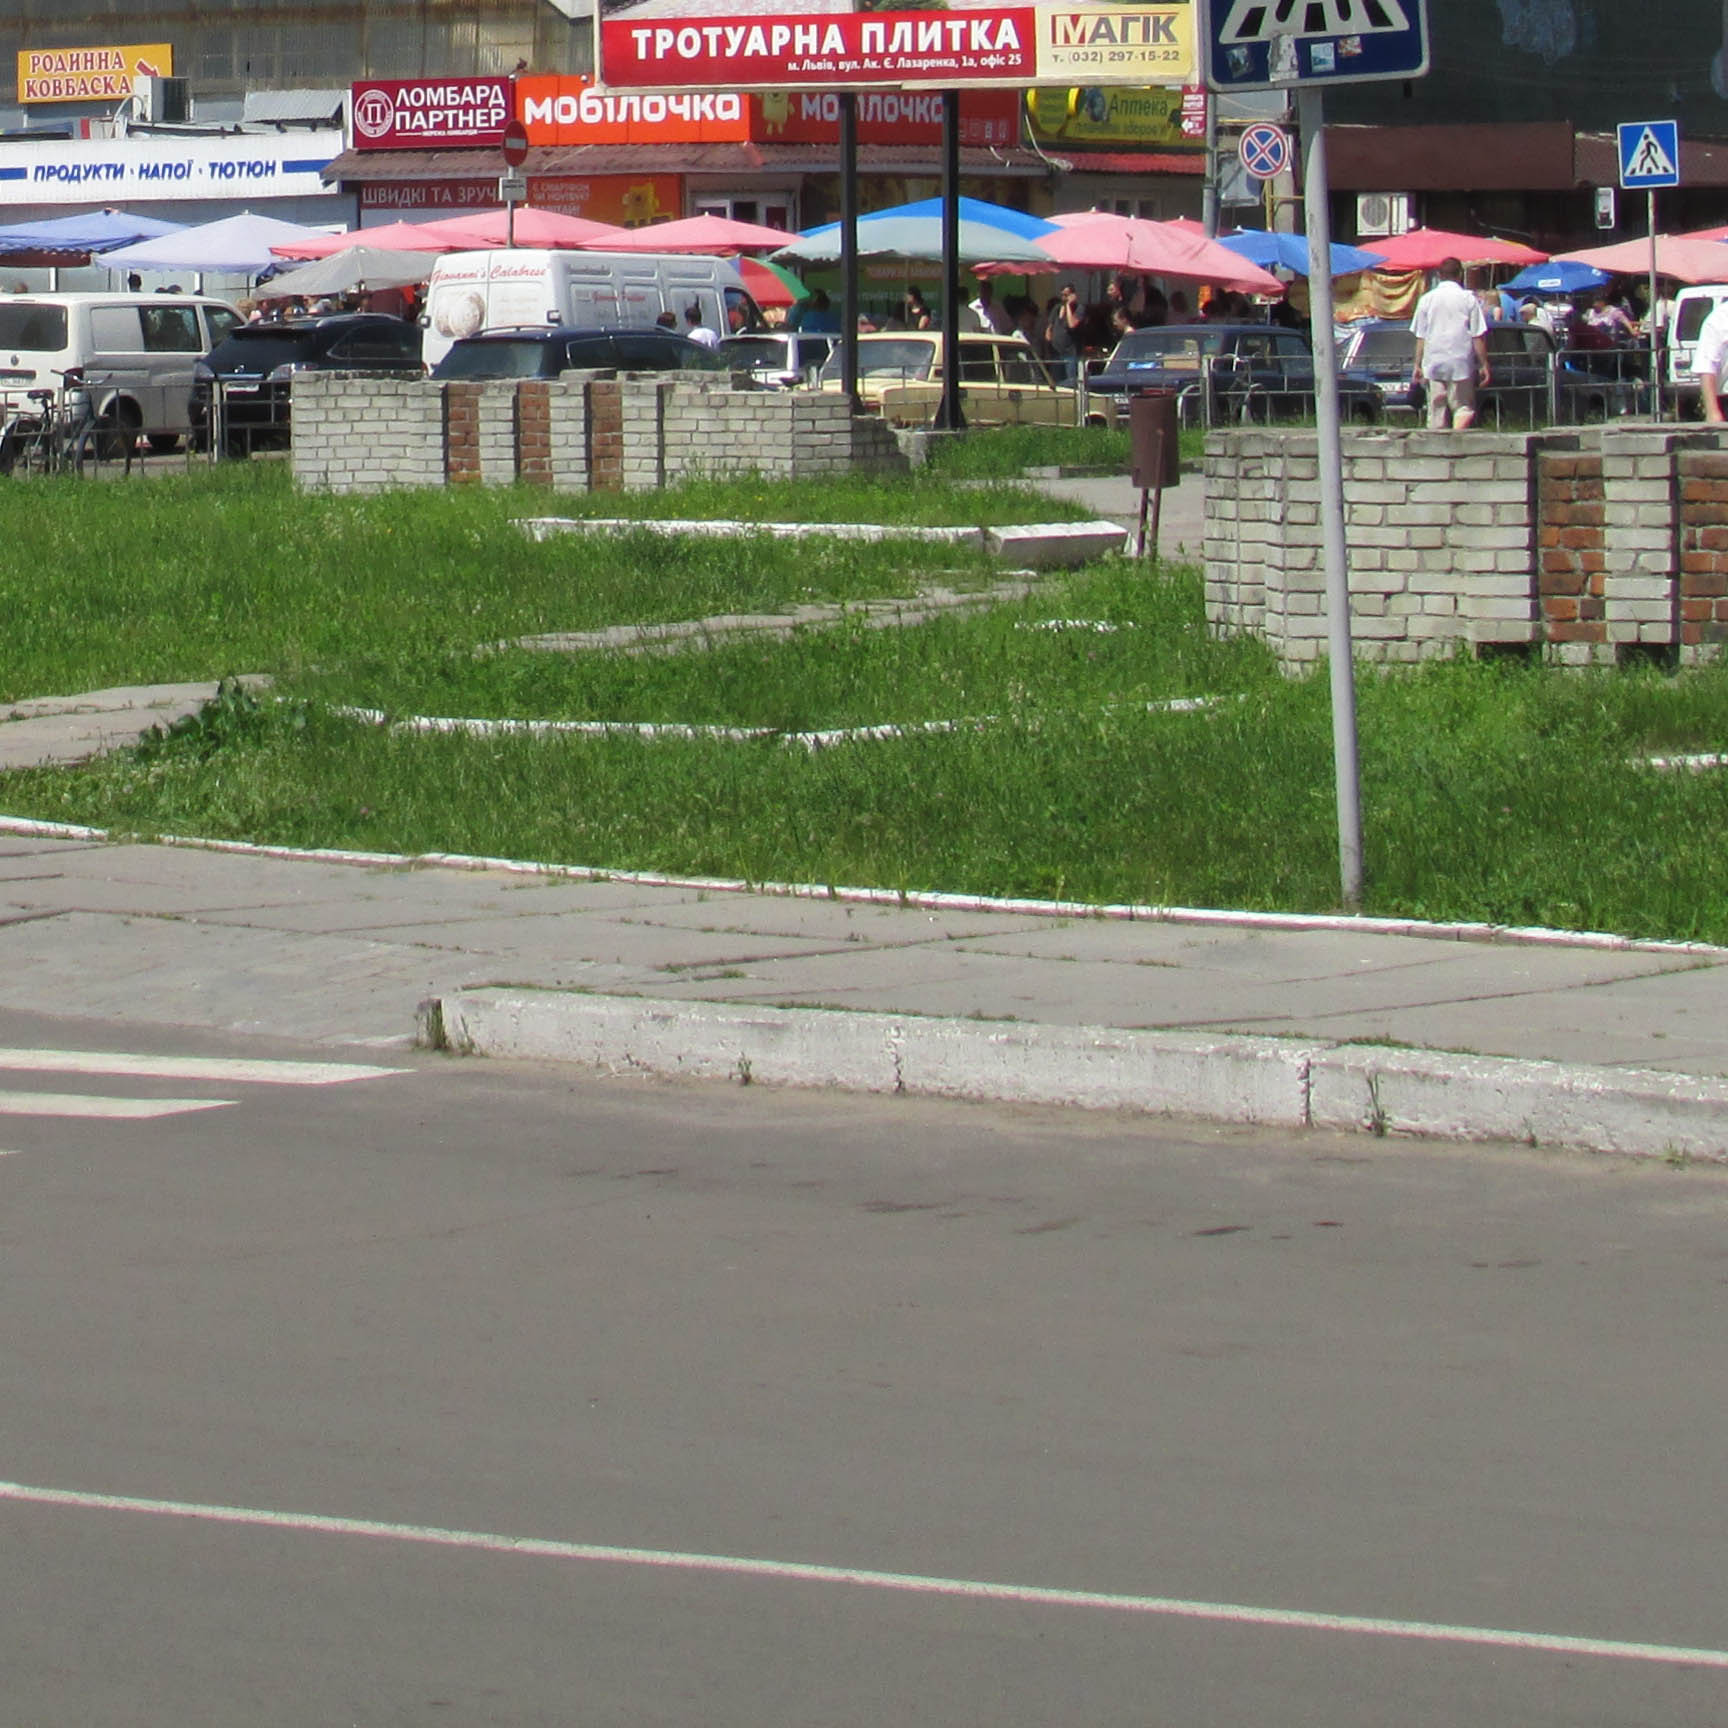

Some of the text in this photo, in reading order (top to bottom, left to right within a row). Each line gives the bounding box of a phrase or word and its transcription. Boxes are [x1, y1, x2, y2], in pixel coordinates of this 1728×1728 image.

[632, 18, 1020, 60] ТРОТУАРНА ПЛИТКА
[1052, 14, 1178, 45] МАГІК
[31, 50, 124, 72] РОДИННА
[839, 60, 860, 73] вул.
[897, 54, 959, 71] Лазаренка,
[981, 54, 1005, 69] офіс
[1008, 54, 1022, 65] 25
[1069, 51, 1103, 64] (032)
[1109, 50, 1180, 62] 297-15-22
[26, 75, 131, 98] КОВБАСКА
[395, 85, 506, 108] ЛОМБАРД
[524, 87, 741, 125] мобілочка
[801, 94, 945, 122] моілочка
[395, 108, 506, 130] ПАРТНЕР
[34, 159, 278, 184] ПРОДУКТИ НАПОЇ ТЮТЮН
[362, 185, 497, 207] ШВИДКІ ТА ЗРУЧ
